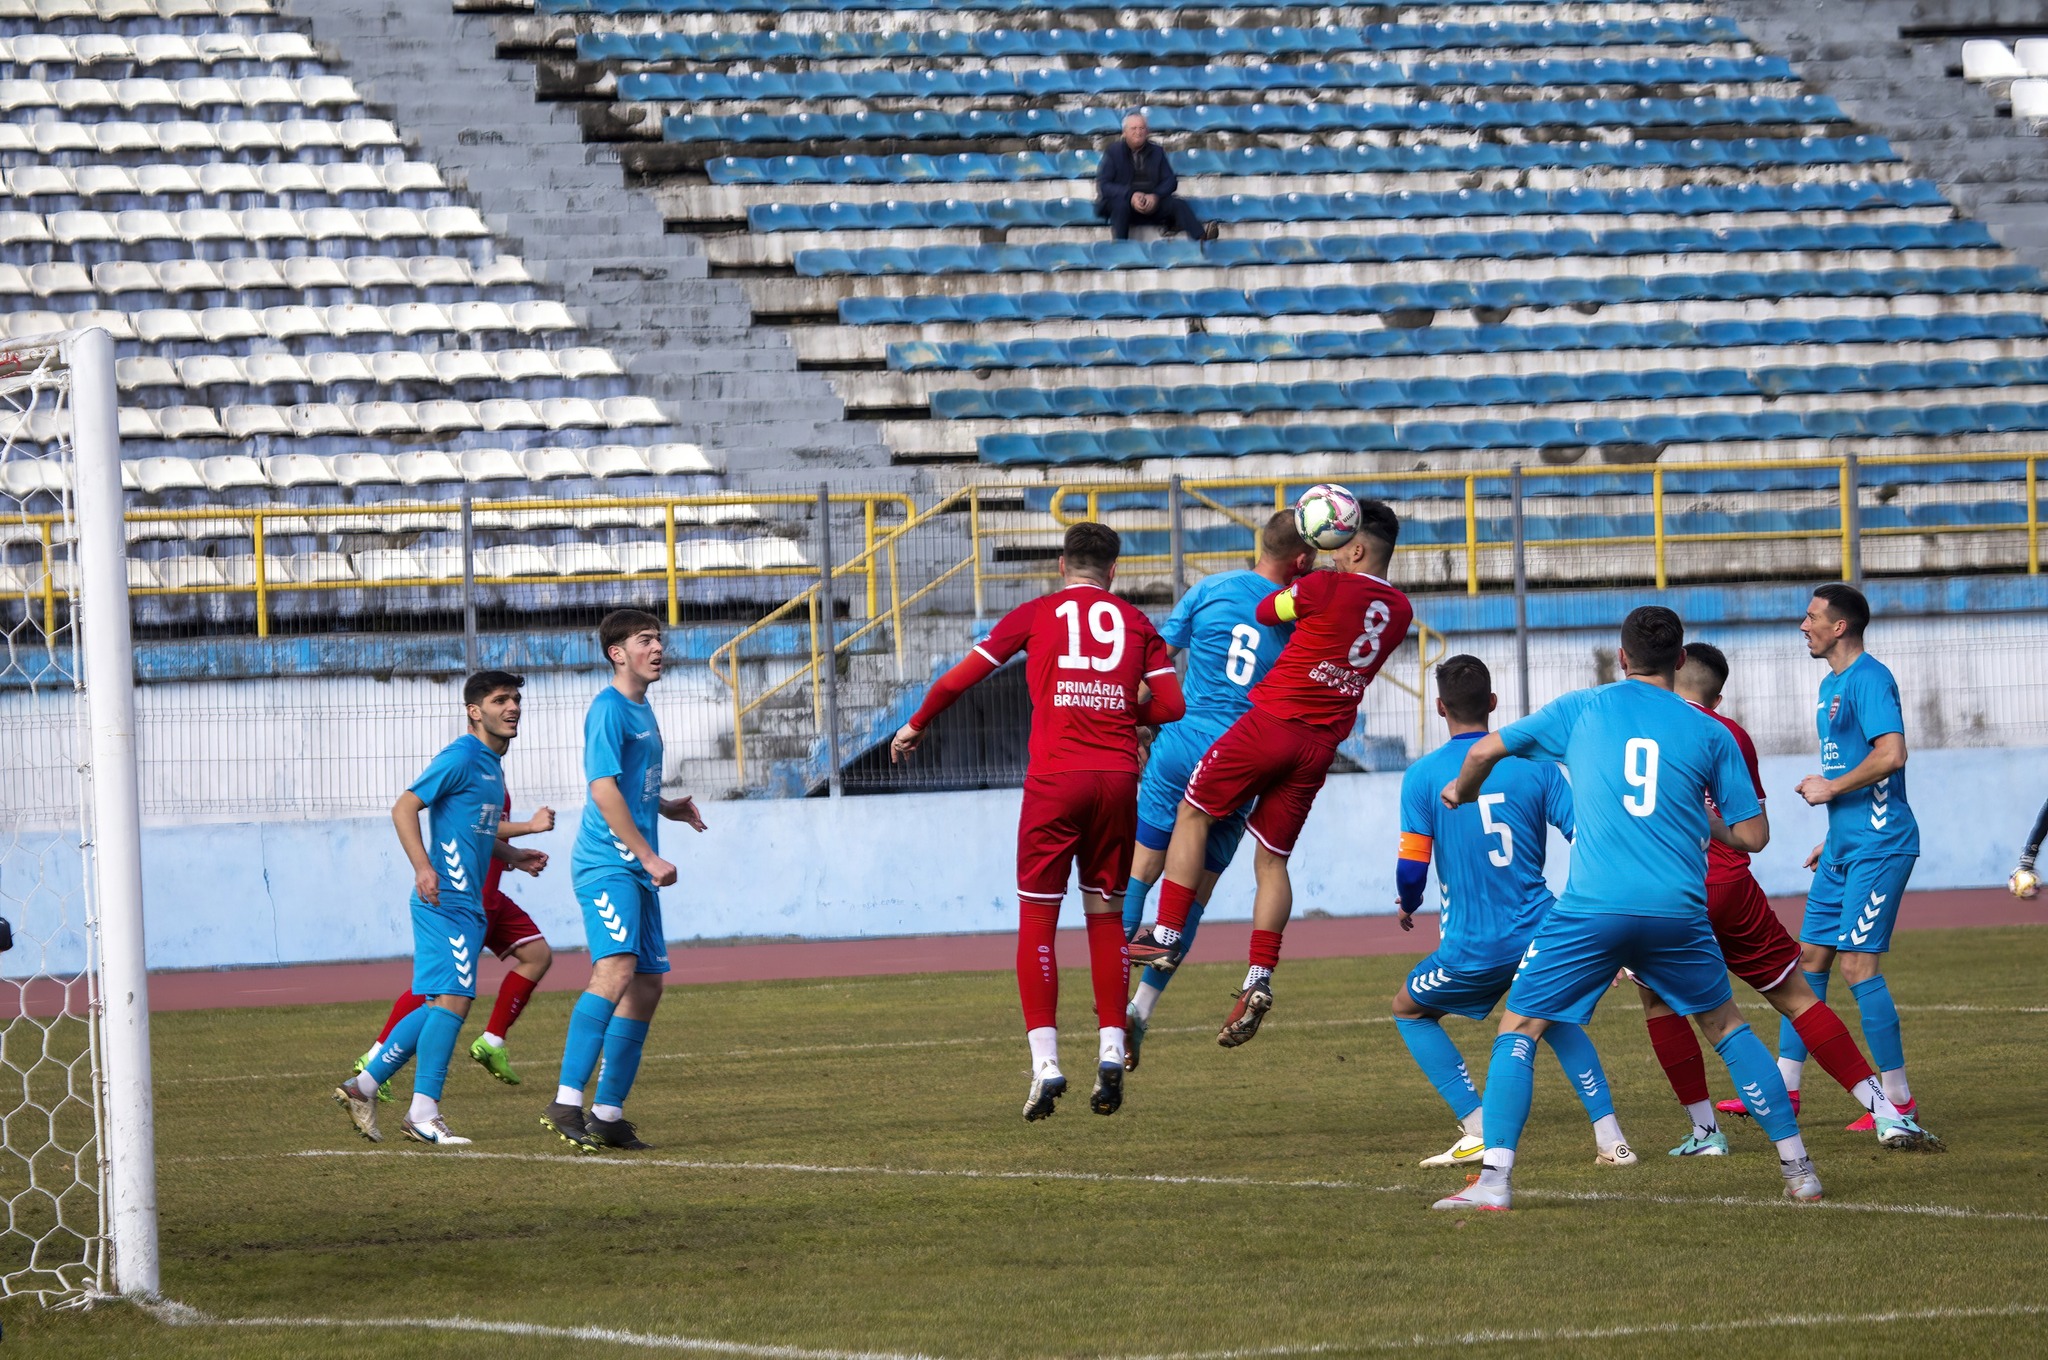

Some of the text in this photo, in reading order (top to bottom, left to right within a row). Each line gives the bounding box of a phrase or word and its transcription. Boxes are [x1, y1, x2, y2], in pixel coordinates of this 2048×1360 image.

[1055, 600, 1125, 672] 19
[1225, 623, 1260, 686] 6
[1348, 600, 1390, 668] 8
[1057, 680, 1124, 697] PRIMĂRIA
[1622, 737, 1659, 816] 9
[1477, 792, 1513, 867] 5
